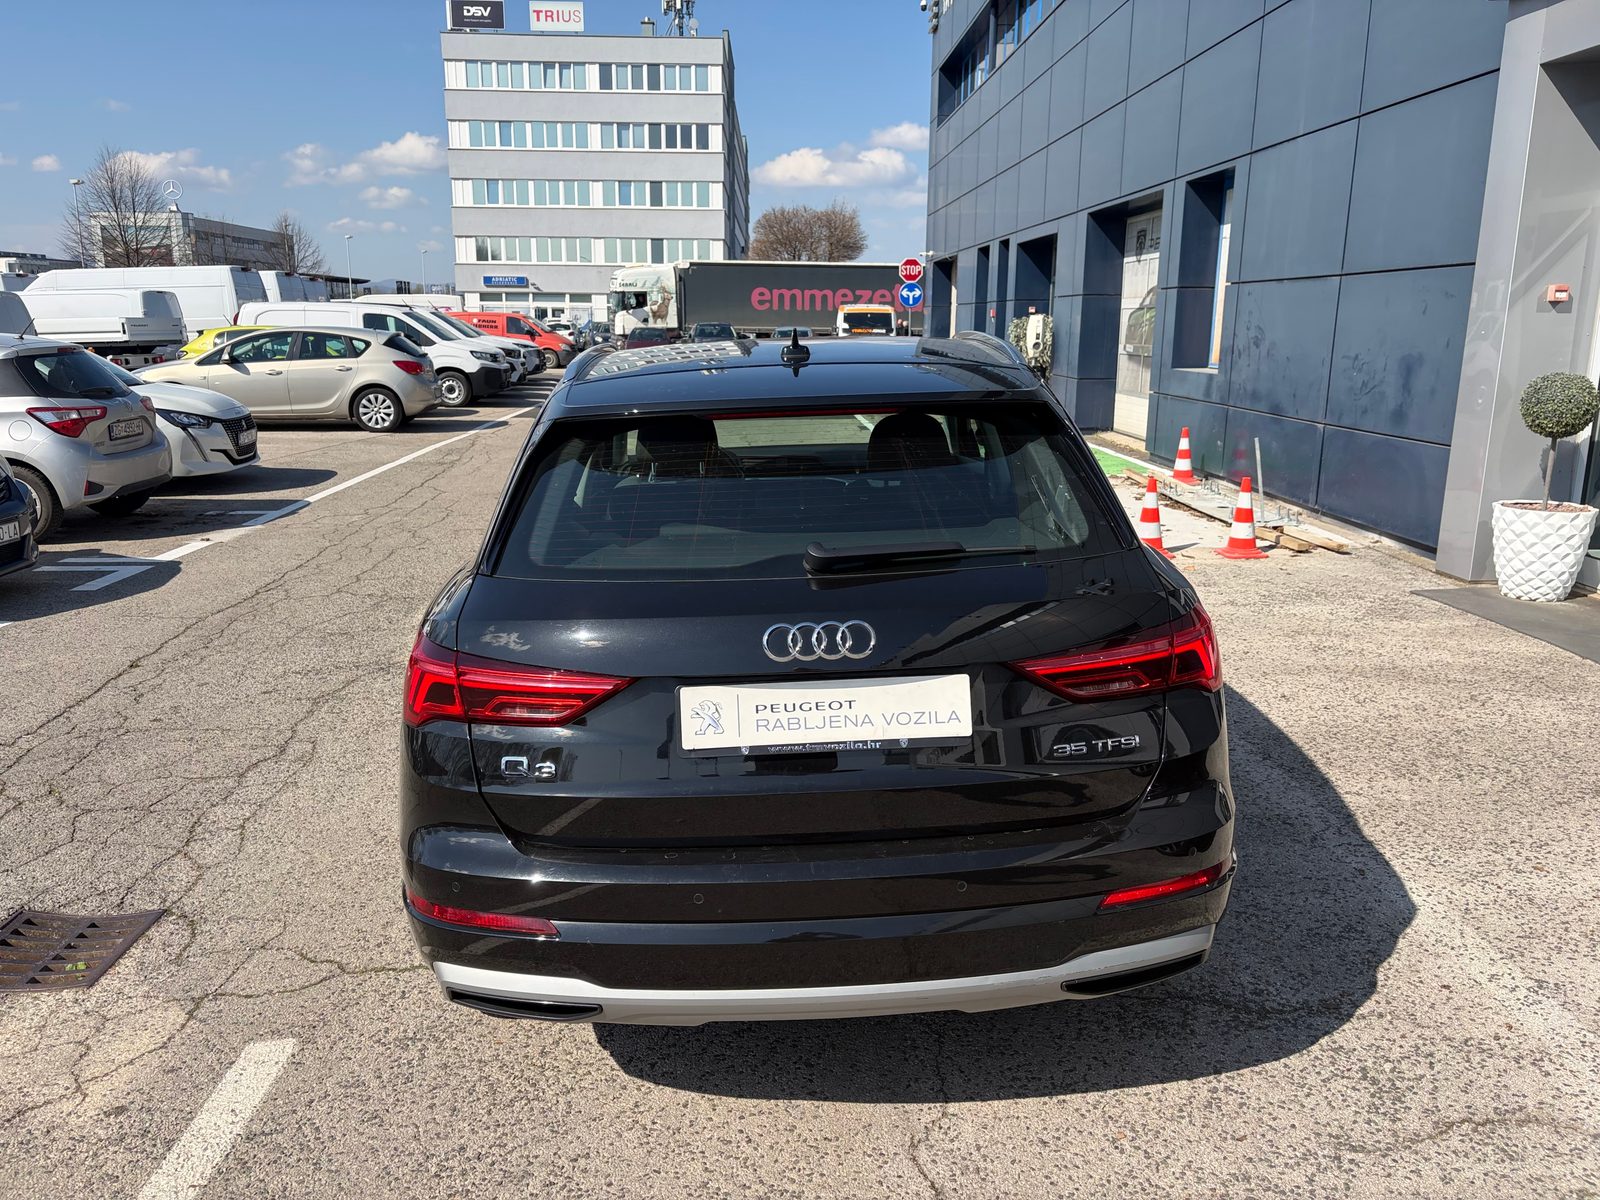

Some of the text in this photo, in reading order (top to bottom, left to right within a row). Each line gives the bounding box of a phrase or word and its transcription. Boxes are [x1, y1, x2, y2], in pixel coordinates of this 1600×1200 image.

[463, 6, 491, 17] DSV
[532, 10, 582, 23] TRIUS
[901, 264, 921, 276] STOP
[755, 699, 857, 714] PEUGEOT
[756, 710, 962, 733] RABLJENA VOZILA
[1053, 734, 1140, 757] 35 TFSI
[500, 756, 556, 779] Q3
